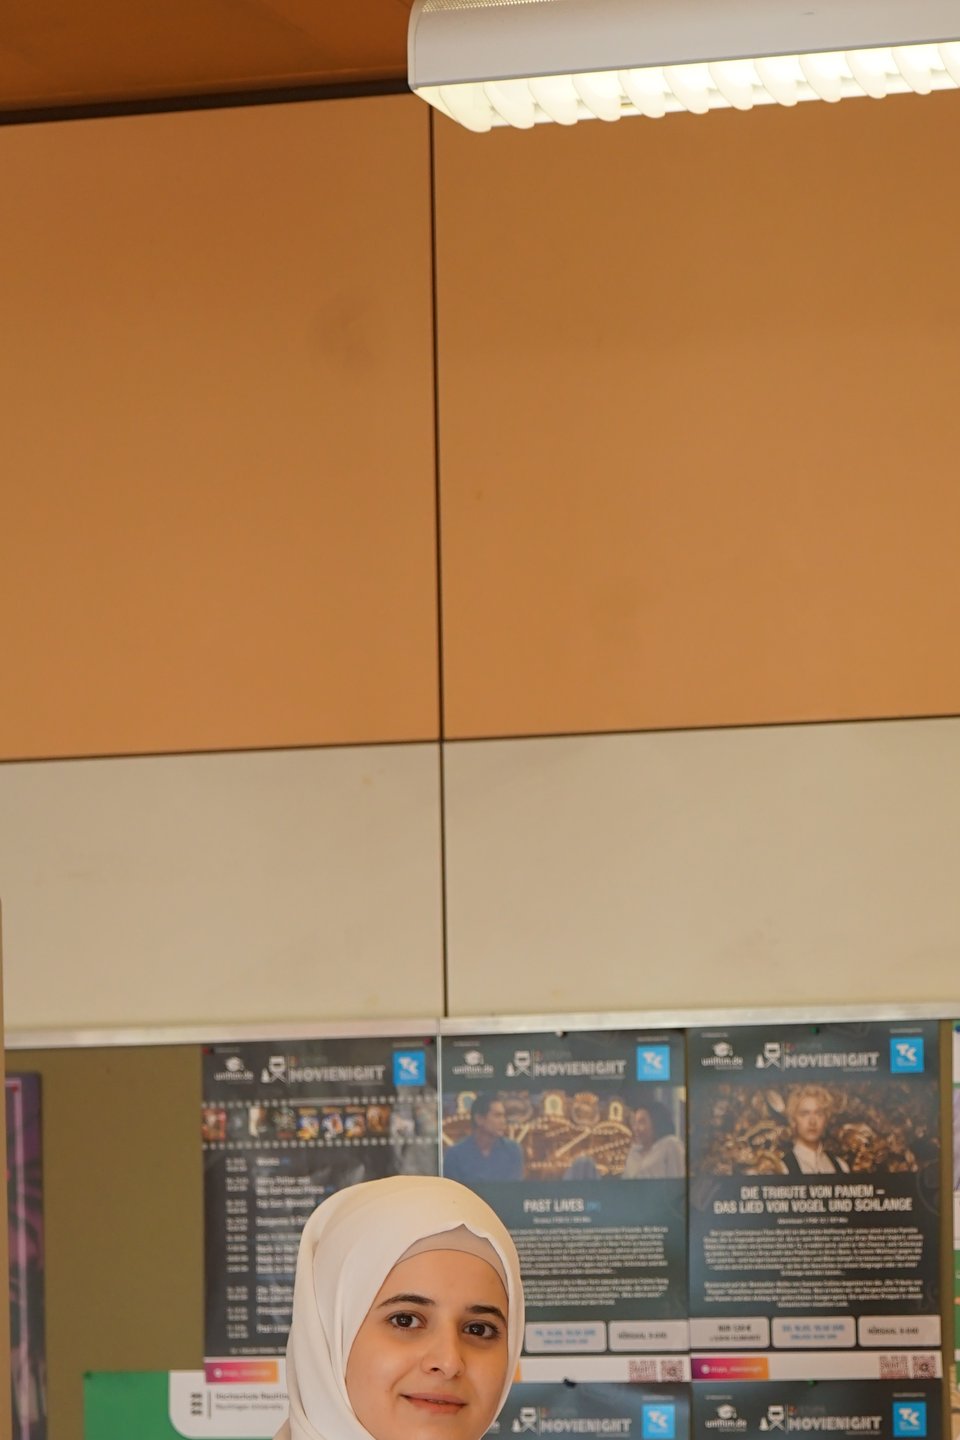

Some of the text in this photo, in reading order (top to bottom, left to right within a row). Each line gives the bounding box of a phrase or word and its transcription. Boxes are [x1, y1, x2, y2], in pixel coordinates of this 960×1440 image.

[533, 1060, 627, 1077] MOVIENIGHT
[784, 1052, 880, 1069] MOVIENIGHT
[290, 1065, 385, 1083] MOVIENIGHT
[741, 1186, 759, 1199] DIE
[763, 1185, 807, 1199] TRIBUTE
[810, 1184, 832, 1198] VON
[835, 1184, 874, 1198] PANEM
[523, 1199, 551, 1213] PAST
[554, 1198, 585, 1213] LIVES
[714, 1198, 912, 1215] DAS LIED VON VOGEL UND SCHLANGE
[541, 1418, 632, 1434] MOVIENIGHT
[790, 1415, 882, 1432] MOVIENIGHT
